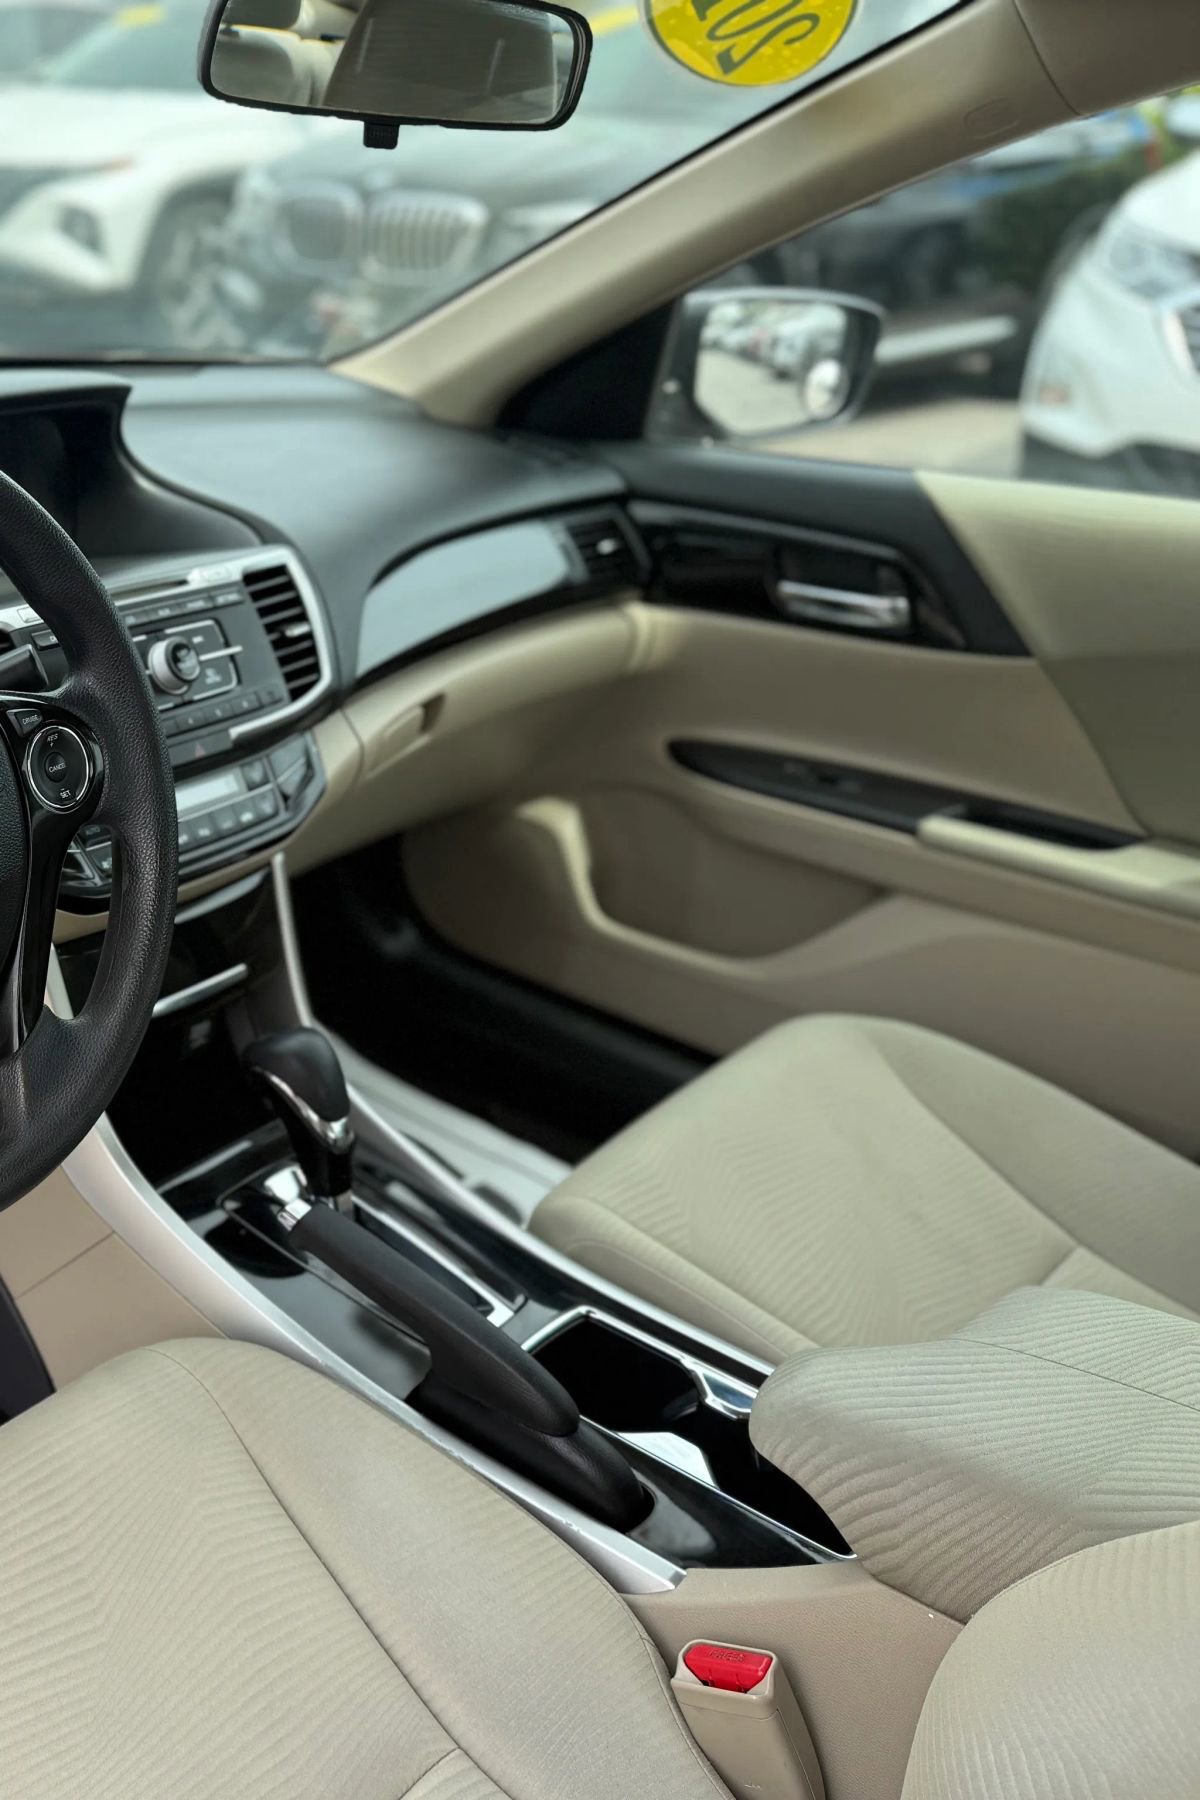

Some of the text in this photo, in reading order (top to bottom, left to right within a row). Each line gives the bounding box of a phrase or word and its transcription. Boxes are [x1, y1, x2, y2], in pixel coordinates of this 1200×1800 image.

[22, 714, 38, 724] CRUISE
[47, 733, 58, 742] RES
[60, 790, 71, 799] SET
